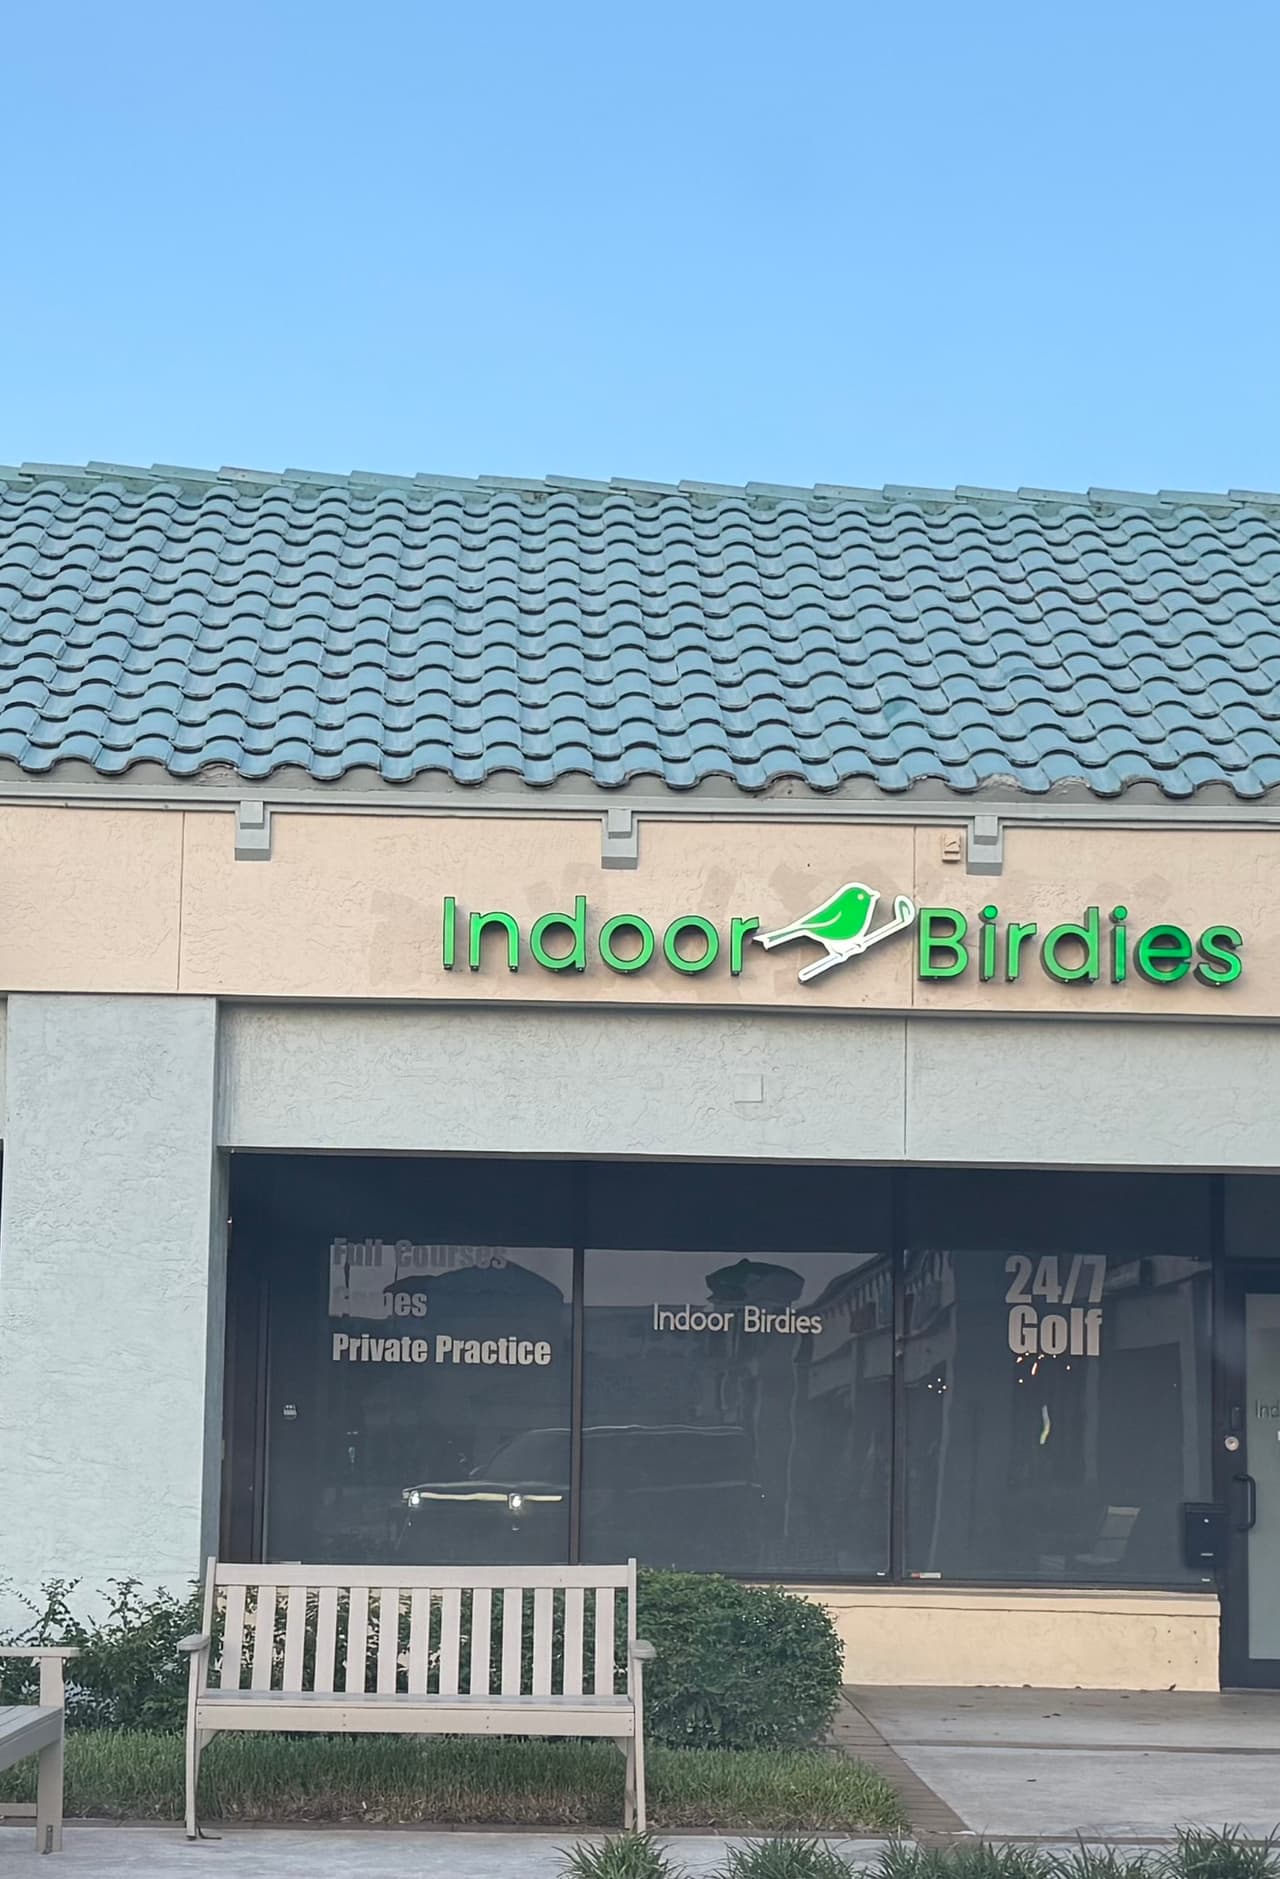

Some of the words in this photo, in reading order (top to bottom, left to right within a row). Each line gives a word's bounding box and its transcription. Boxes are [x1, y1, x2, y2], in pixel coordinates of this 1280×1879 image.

[441, 895, 760, 976] Indoor
[918, 904, 1243, 987] Birdies
[1005, 1254, 1107, 1304] 24/7
[653, 1303, 734, 1332] Indoor
[743, 1305, 823, 1335] Birdies
[1008, 1305, 1103, 1356] Golf
[332, 1333, 428, 1363] Private
[435, 1335, 552, 1366] Practice
